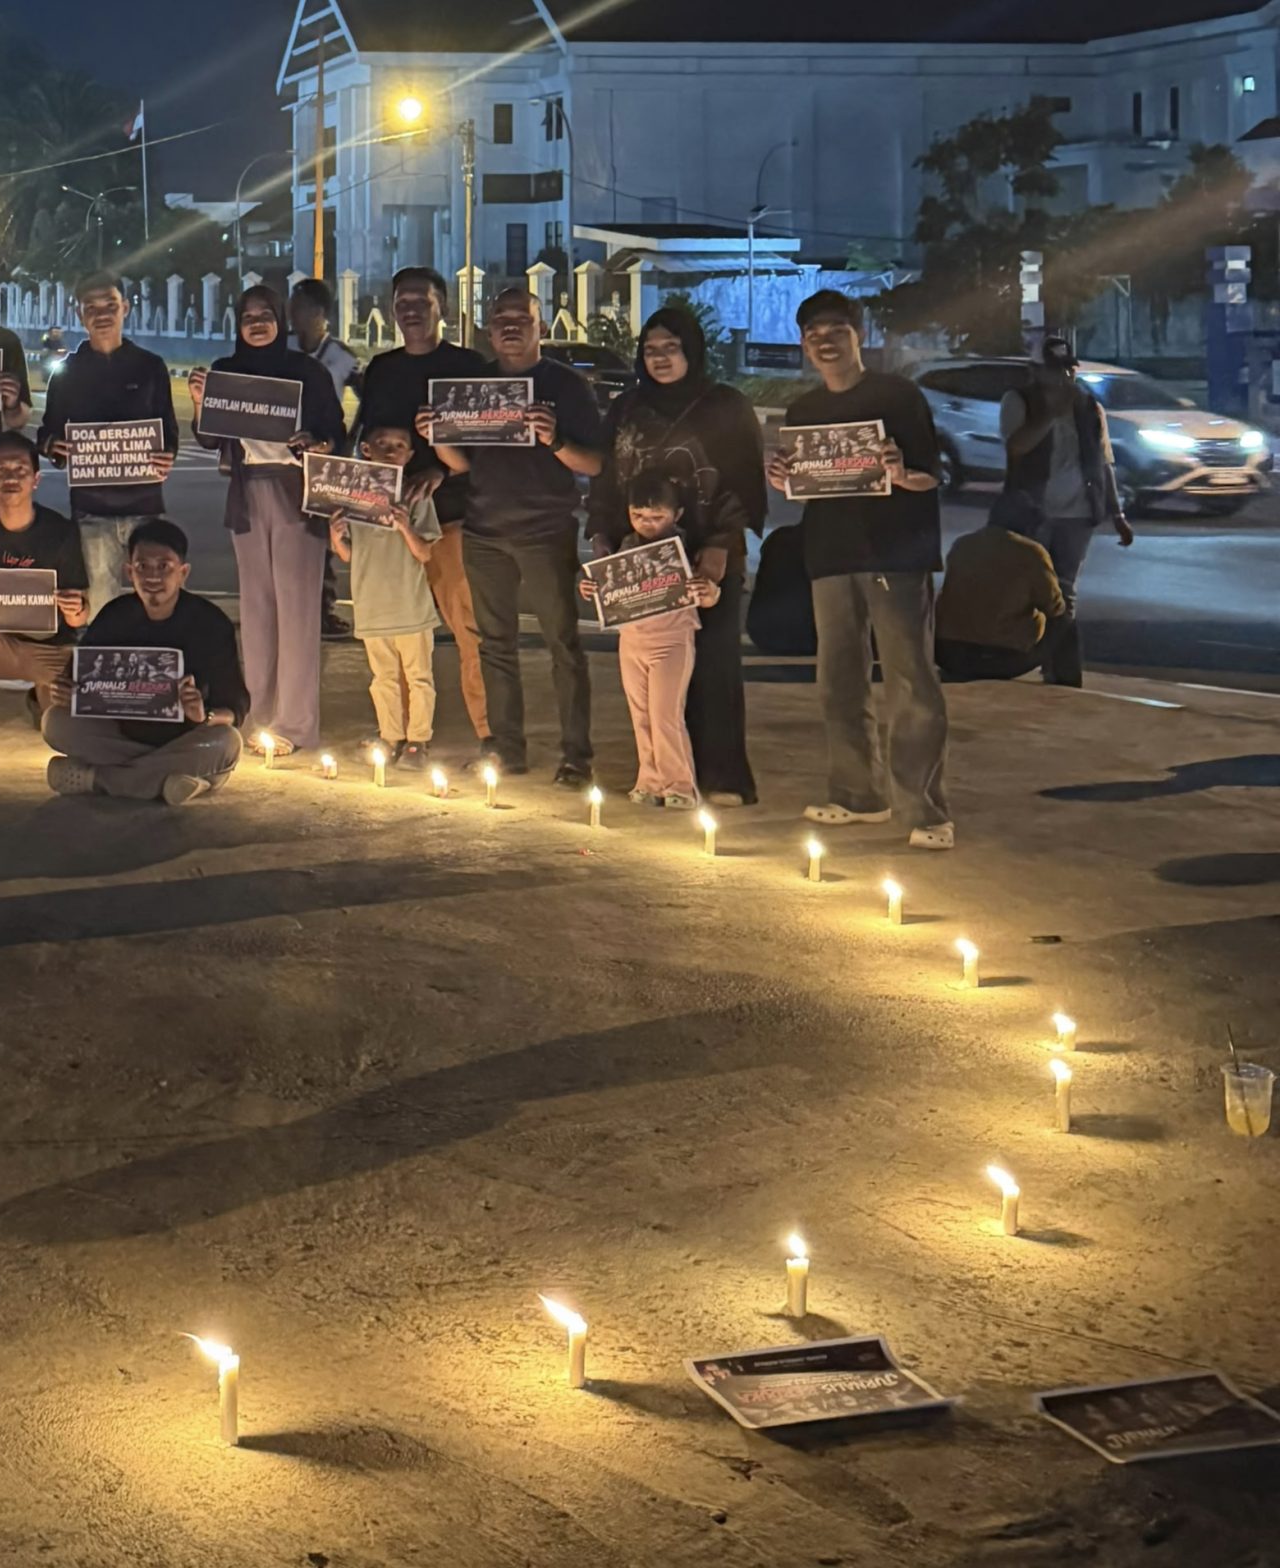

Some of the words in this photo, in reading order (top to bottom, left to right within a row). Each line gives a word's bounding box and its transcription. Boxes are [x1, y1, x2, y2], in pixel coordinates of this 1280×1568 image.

[203, 397, 240, 411] CEPATLAH
[240, 401, 269, 416] PULANG
[270, 405, 297, 418] KAWAN
[440, 410, 479, 422] JURNALIS
[72, 430, 97, 440] DOA
[99, 427, 156, 439] BERSAMA
[77, 441, 120, 453] UNTUK
[123, 440, 152, 451] LIMA
[72, 454, 106, 465] REKAN
[109, 453, 150, 464] JURNAL
[72, 467, 95, 478] DAN
[98, 466, 121, 478] KRU
[790, 458, 833, 475] JURNALIS
[312, 483, 350, 495] JURNALIS
[28, 595, 55, 605] KAWAN
[603, 583, 640, 607] JURNALIS
[81, 680, 127, 694] JURNALIS
[821, 1372, 898, 1394] JURNALIS
